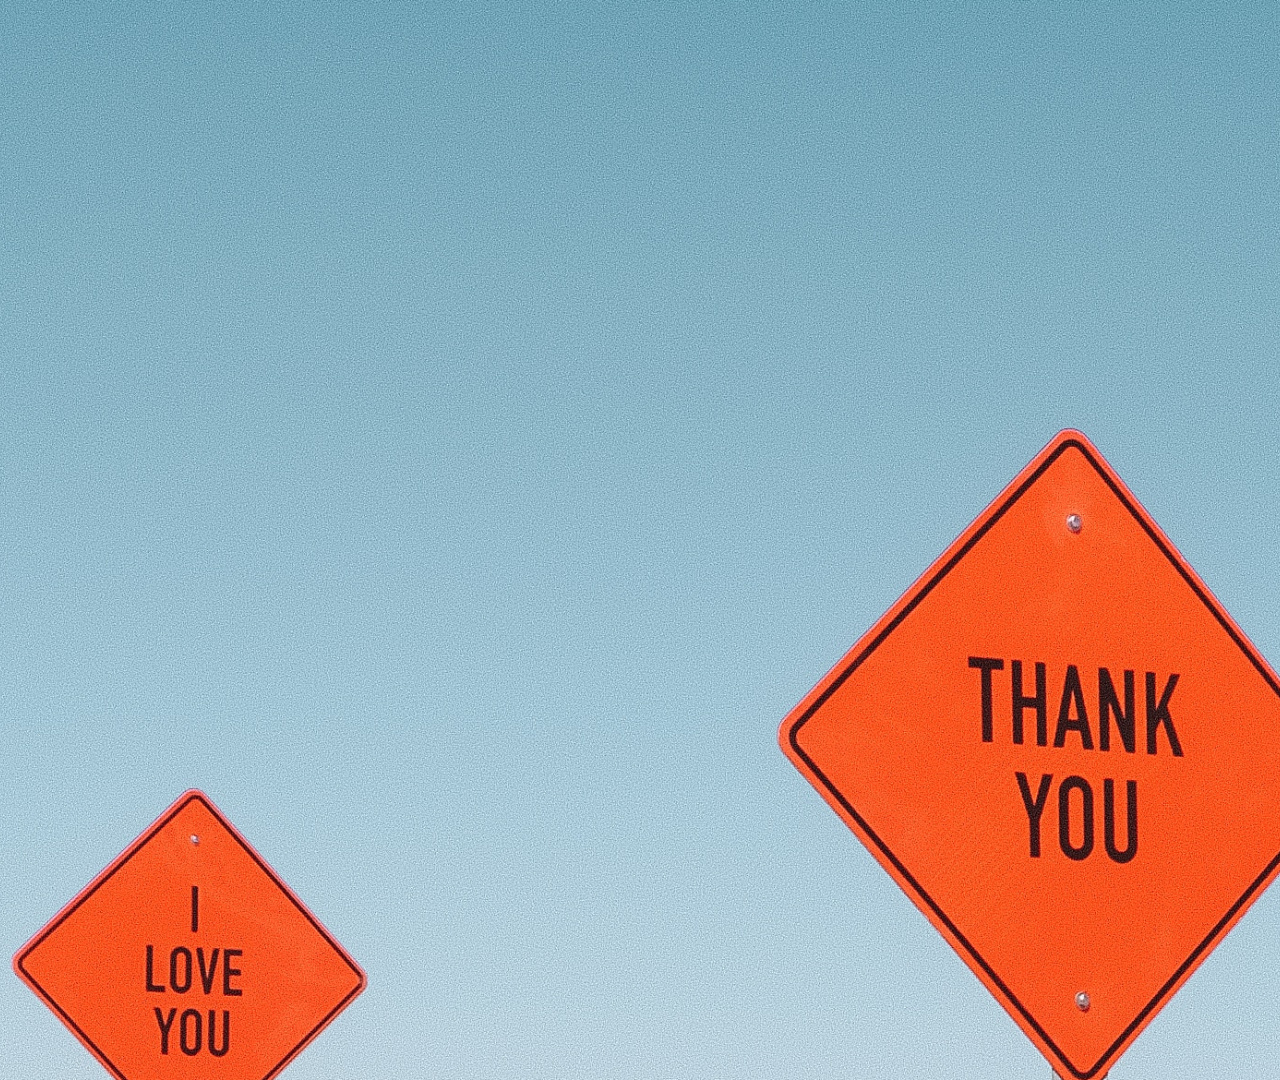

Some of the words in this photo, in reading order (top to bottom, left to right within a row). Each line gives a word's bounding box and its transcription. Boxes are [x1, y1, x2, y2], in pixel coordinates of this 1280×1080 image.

[968, 656, 1184, 757] THANK
[1015, 771, 1138, 864] YOU
[191, 885, 199, 933] I
[145, 944, 243, 996] LOVE
[154, 1006, 230, 1057] YOU
